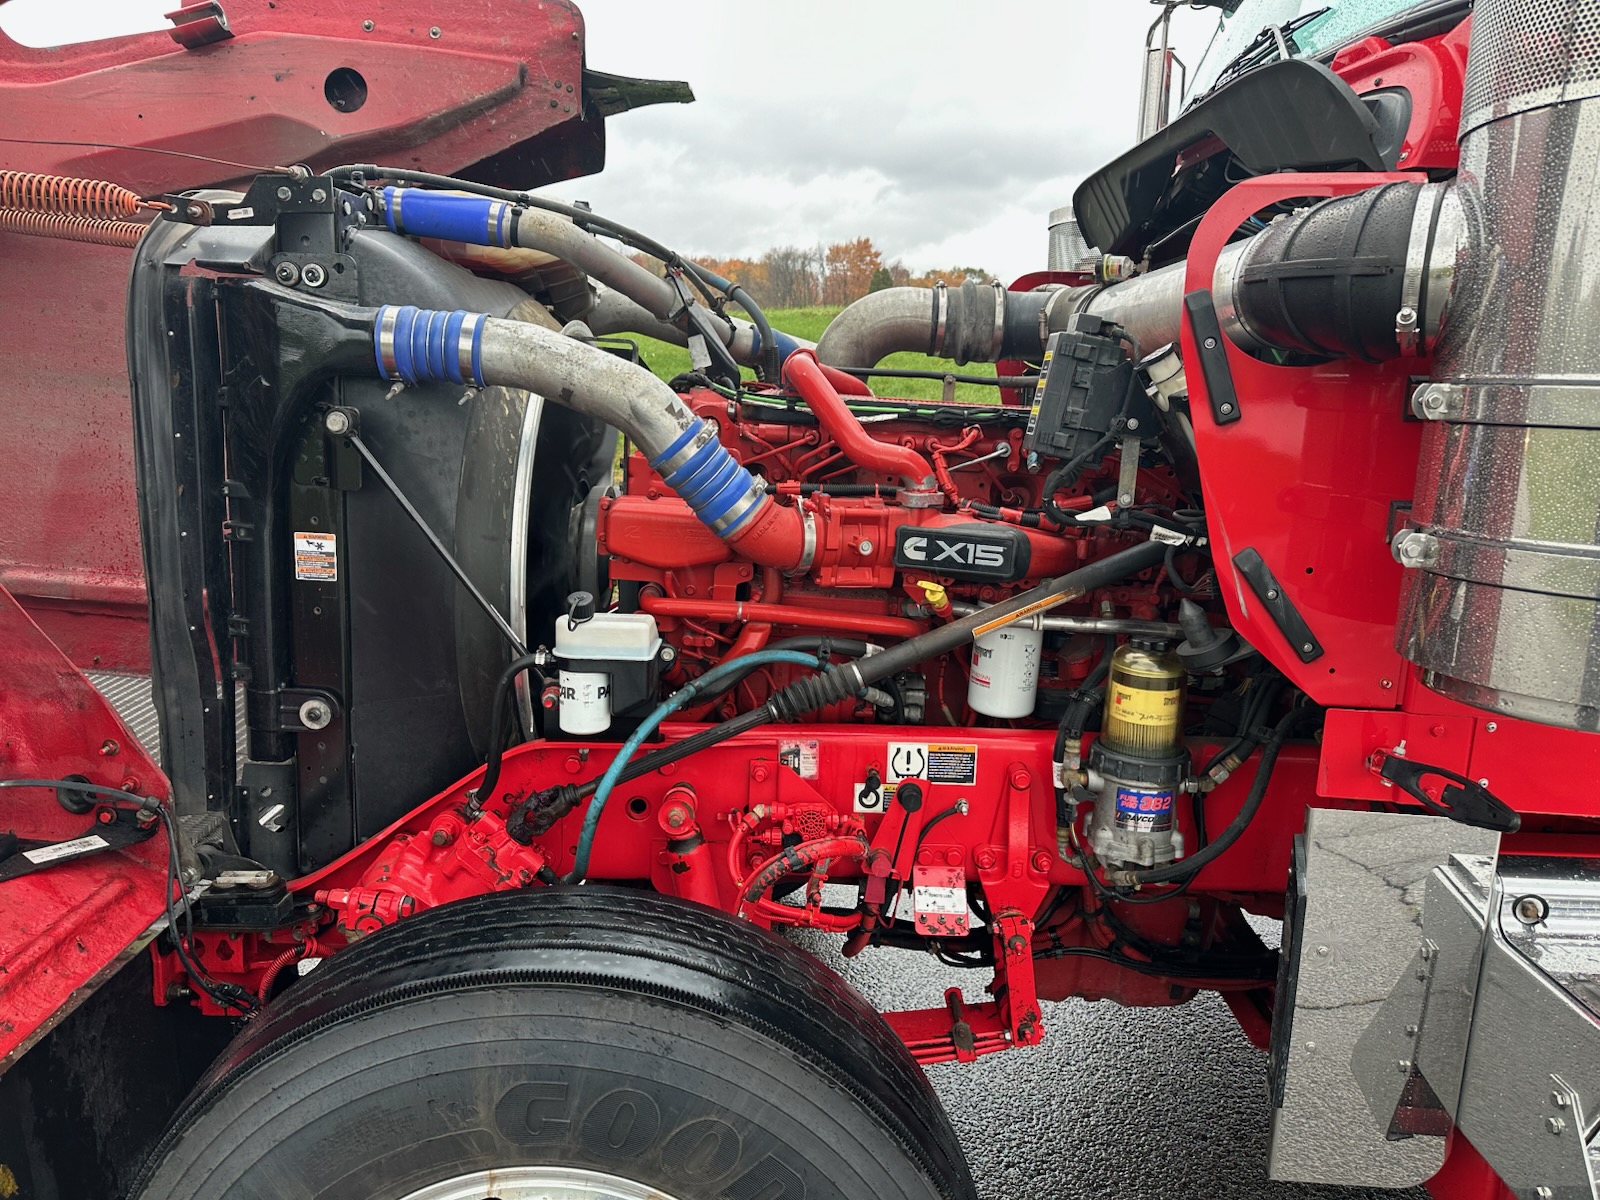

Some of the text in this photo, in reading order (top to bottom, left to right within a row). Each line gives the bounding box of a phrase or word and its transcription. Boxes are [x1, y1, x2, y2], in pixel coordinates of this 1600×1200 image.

[932, 540, 1004, 567] X15
[1019, 603, 1043, 616] WARNING
[559, 685, 576, 700] AR
[1139, 796, 1172, 811] 382
[1125, 812, 1155, 823] DAVCO
